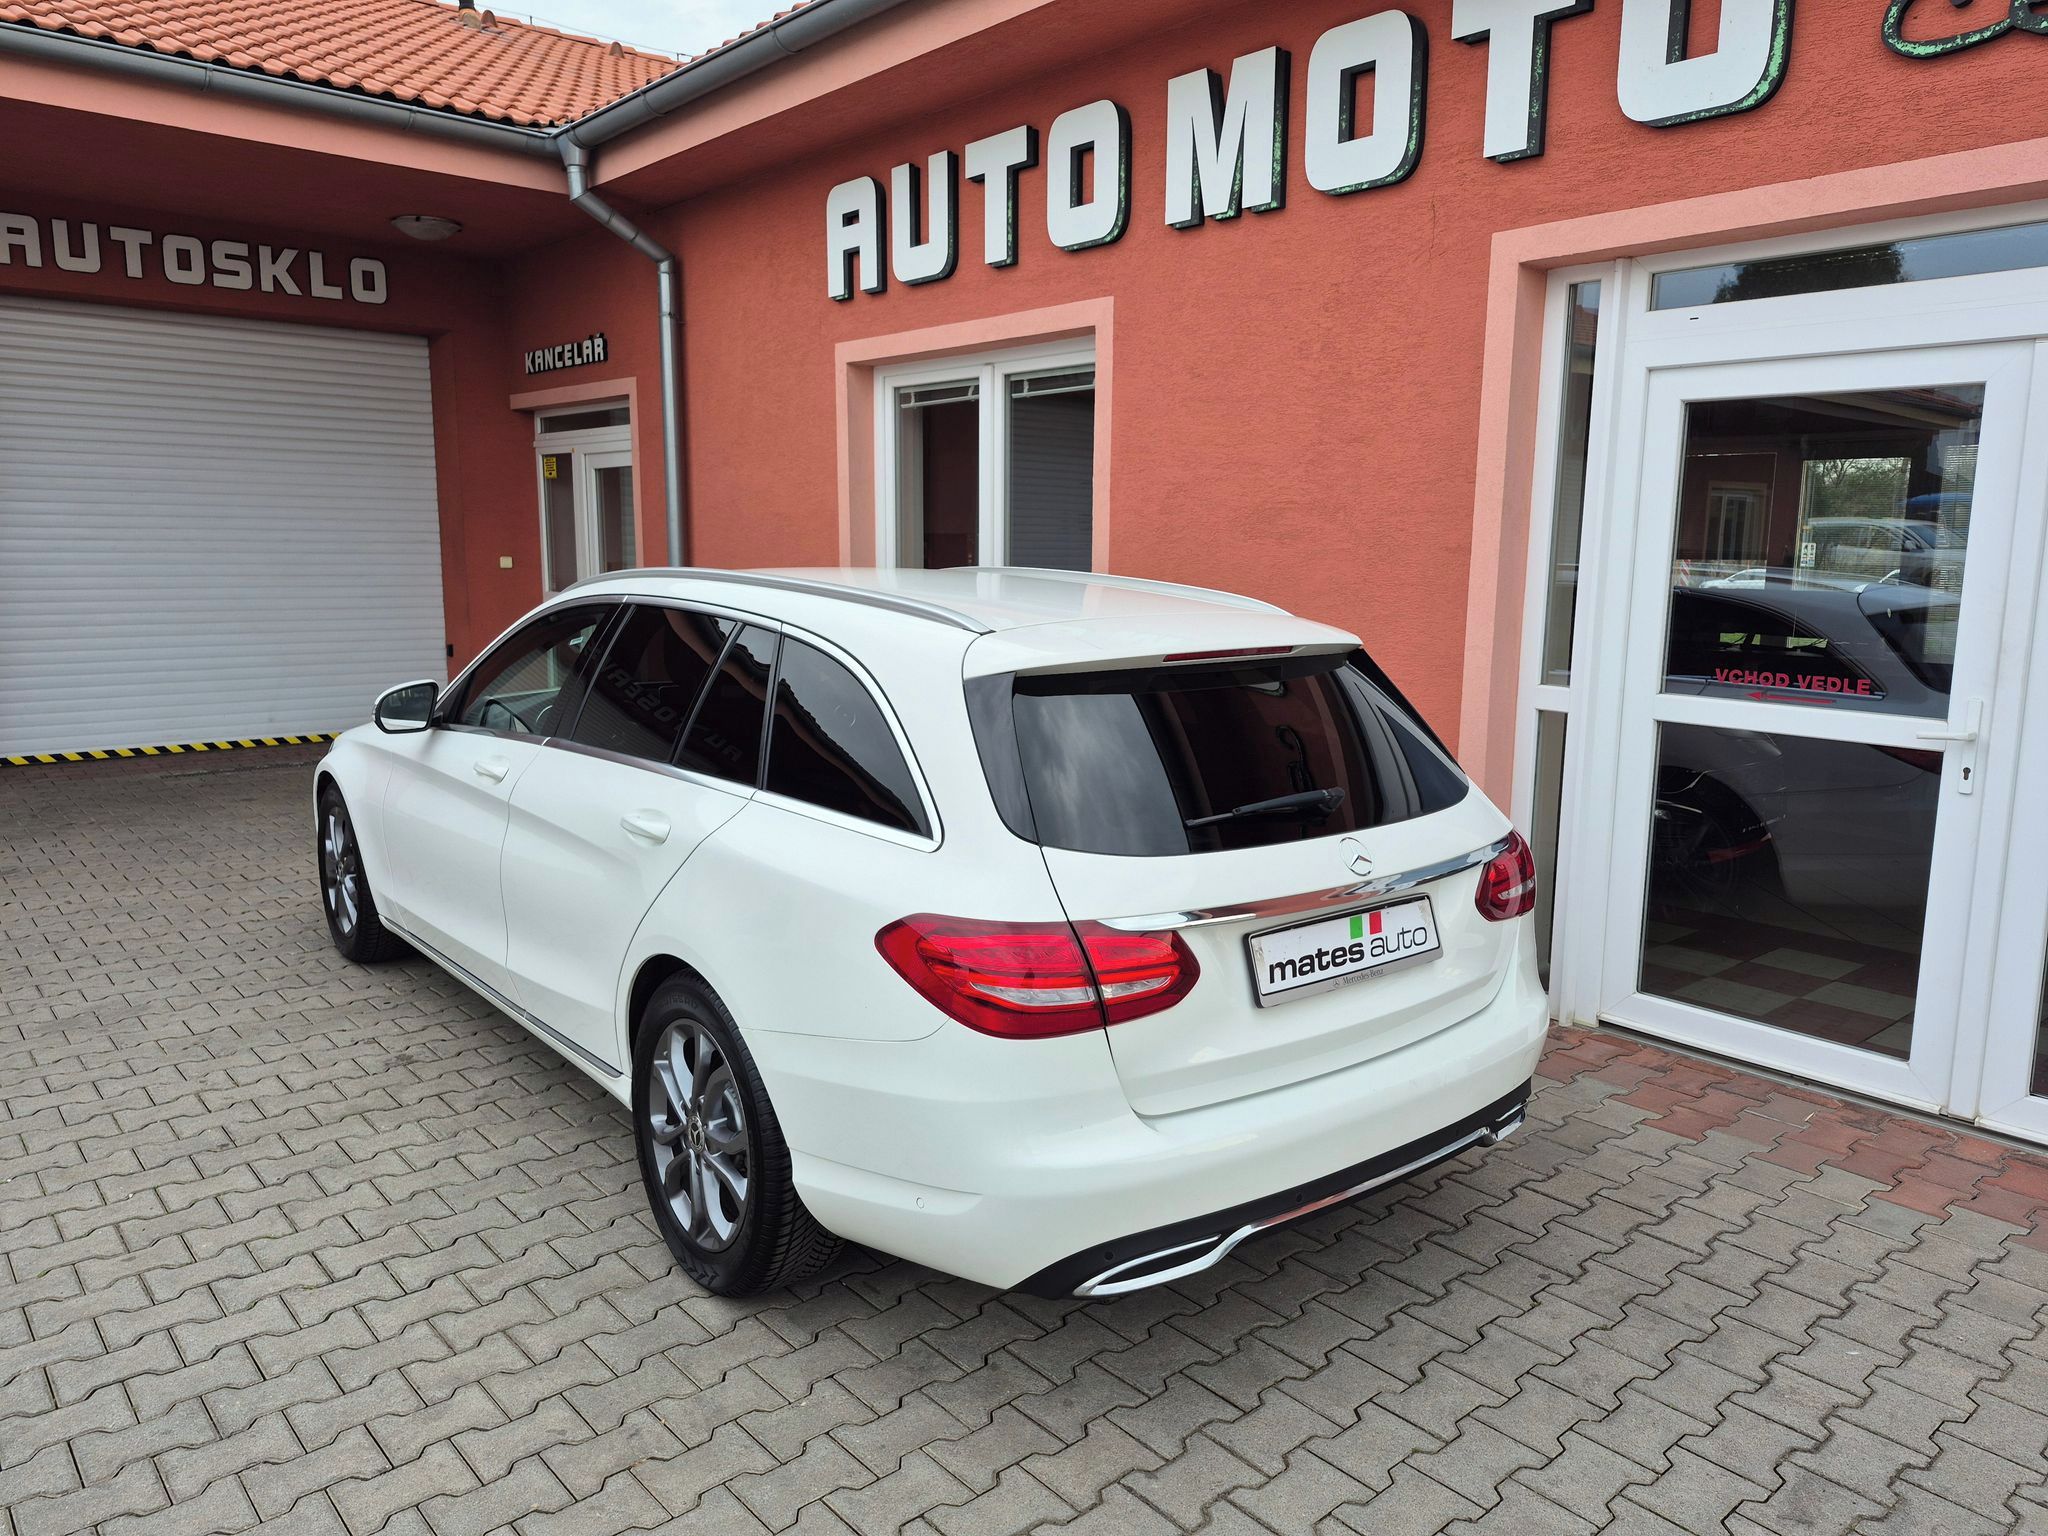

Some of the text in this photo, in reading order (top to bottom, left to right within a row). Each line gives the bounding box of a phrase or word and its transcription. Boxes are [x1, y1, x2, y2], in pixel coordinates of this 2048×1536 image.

[826, 99, 1131, 301] AUTO
[0, 212, 387, 304] AUTOSKLO
[1715, 668, 1871, 695] VCHOD VEDLE
[1269, 926, 1428, 984] mates auto
[1342, 968, 1384, 986] Mercedes-Benz
